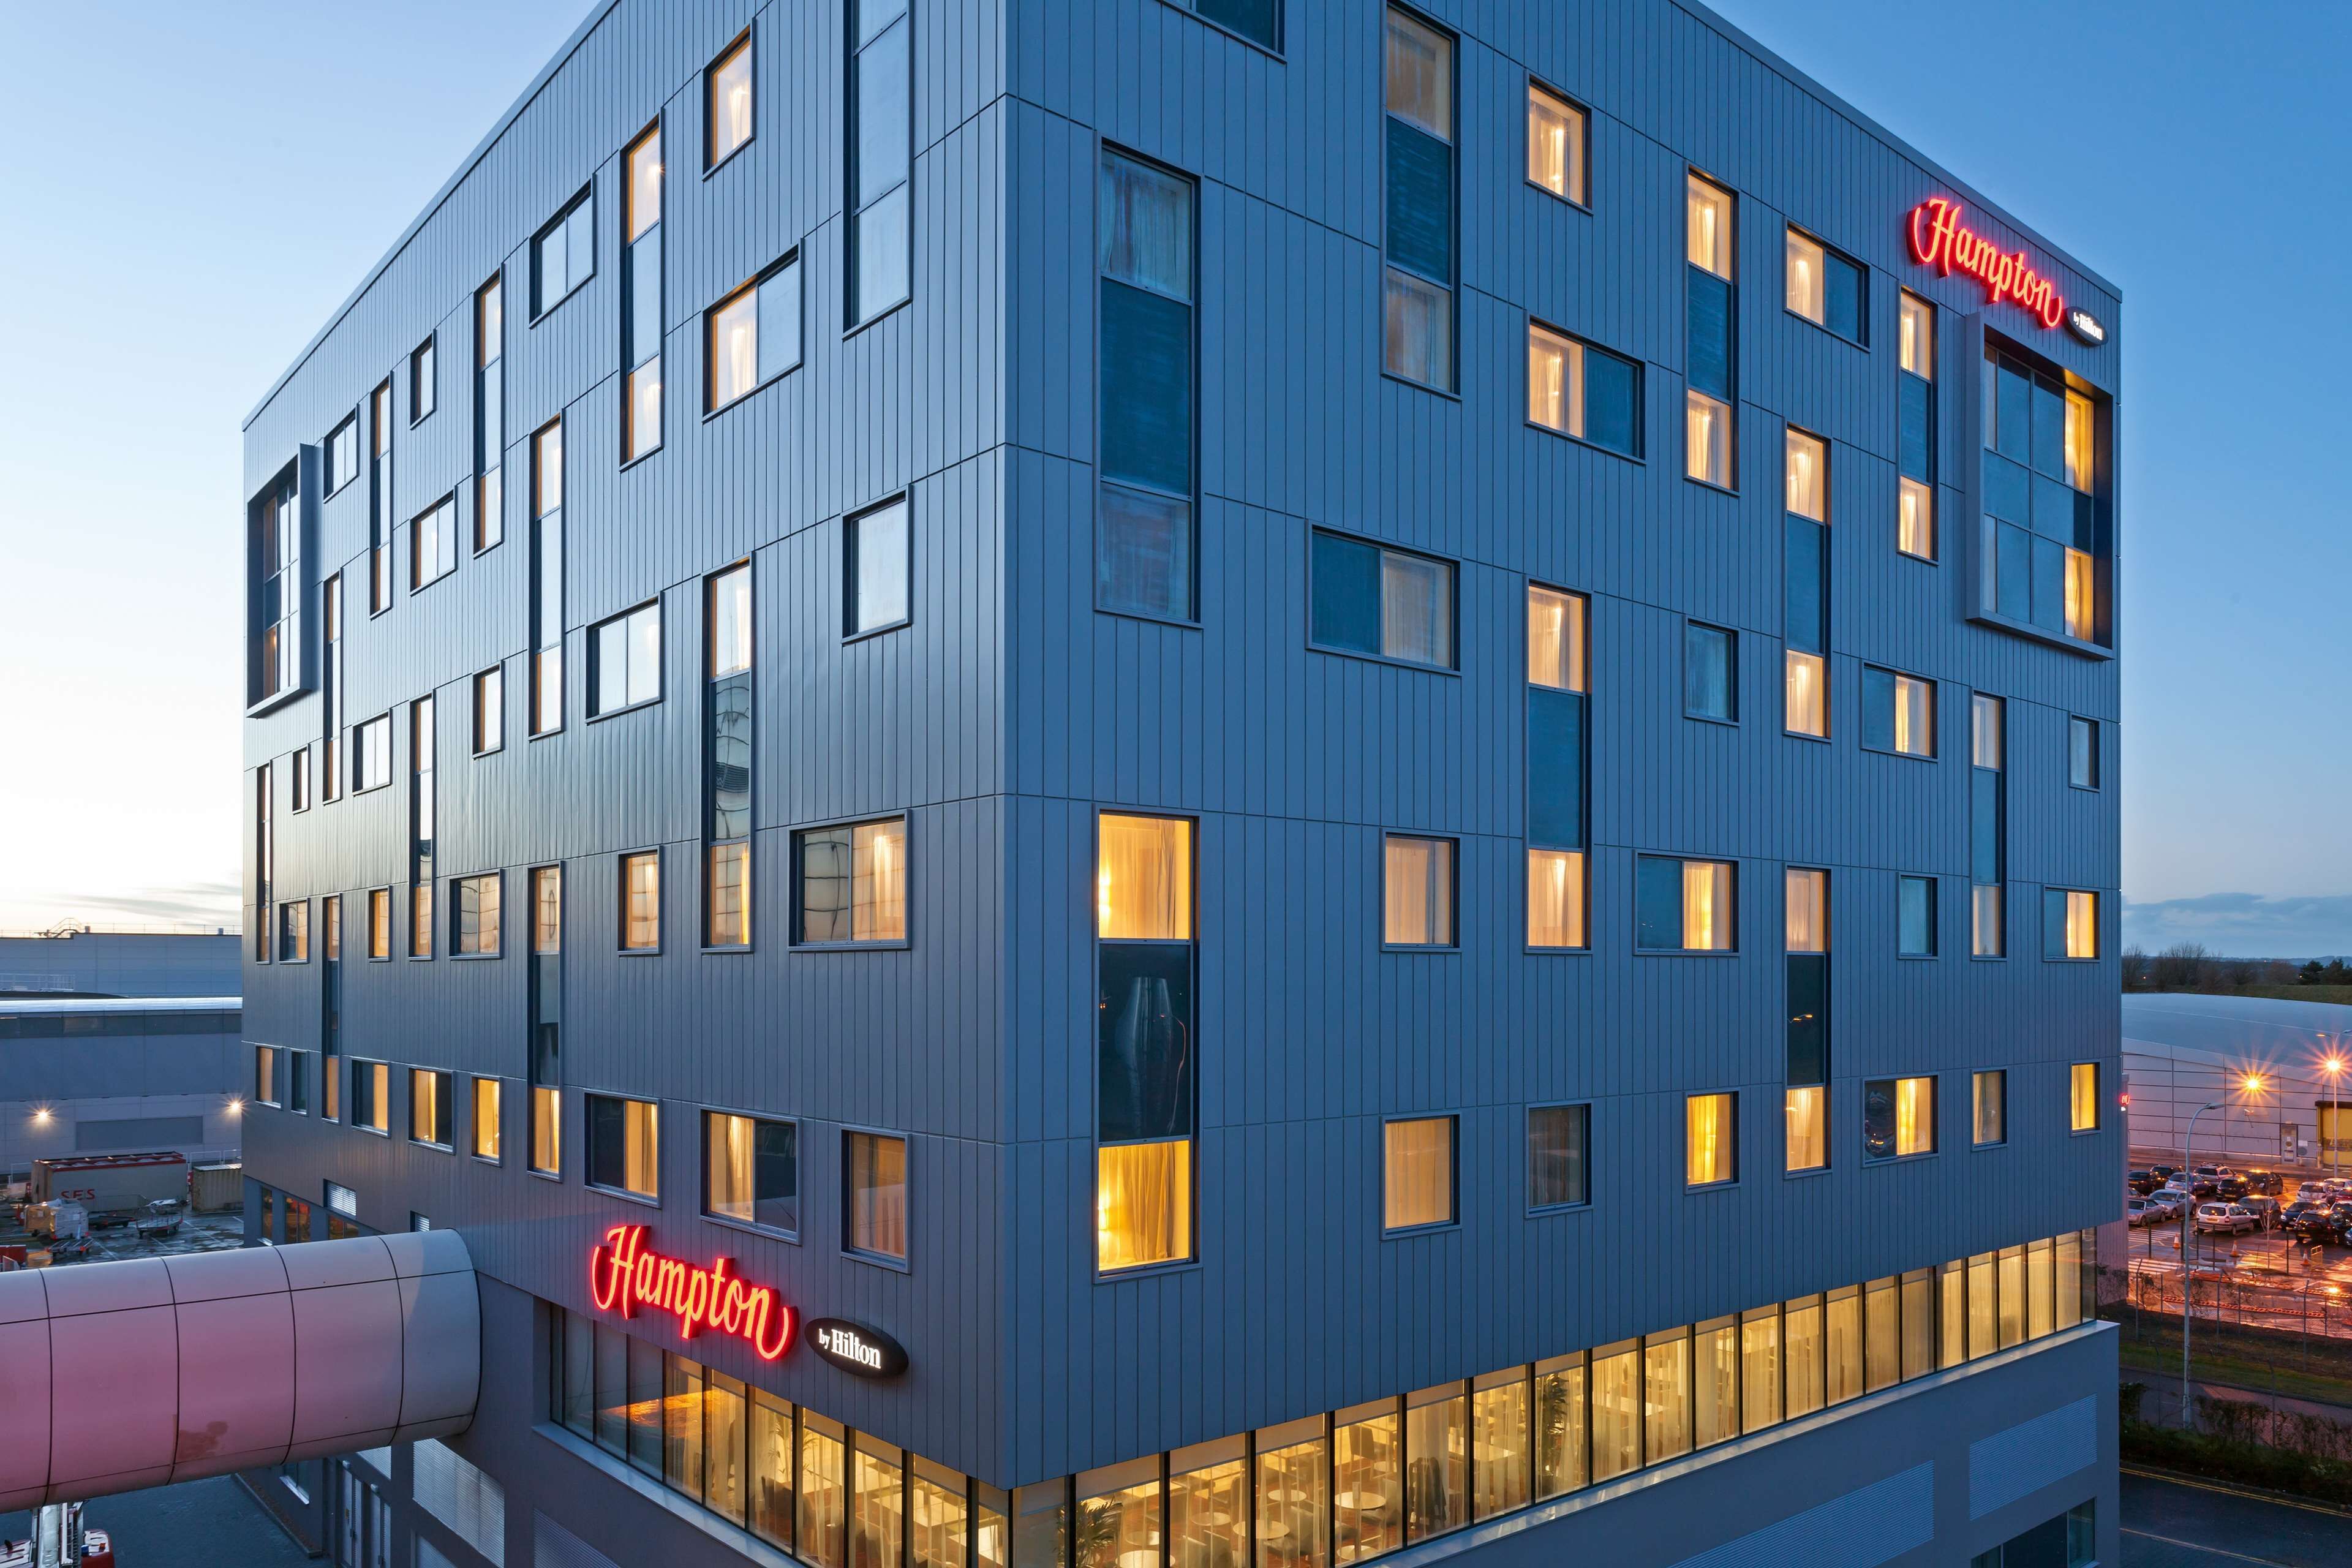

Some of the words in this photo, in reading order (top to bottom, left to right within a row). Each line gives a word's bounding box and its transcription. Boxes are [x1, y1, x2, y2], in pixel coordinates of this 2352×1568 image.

[1912, 198, 2063, 328] Hampton
[2073, 312, 2079, 325] by
[2079, 314, 2103, 341] Hilton
[591, 1225, 790, 1360] Hampton
[819, 1328, 831, 1349] by
[831, 1329, 881, 1370] Hilton
